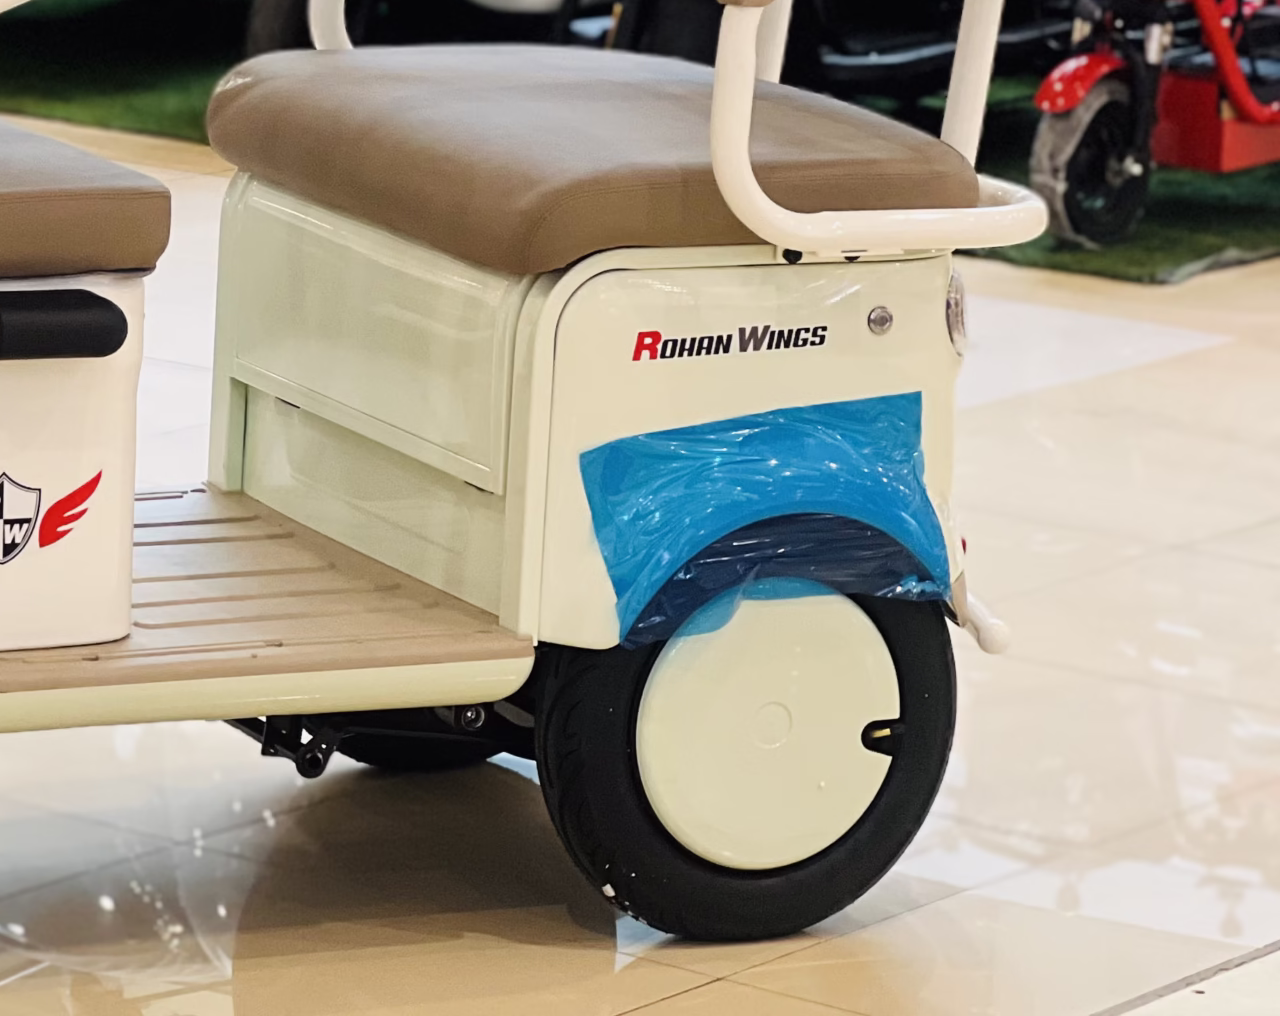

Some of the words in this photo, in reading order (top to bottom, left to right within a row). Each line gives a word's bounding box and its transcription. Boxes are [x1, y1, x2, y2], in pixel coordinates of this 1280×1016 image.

[632, 330, 733, 361] ROHAN
[738, 325, 827, 352] WINGS
[4, 523, 29, 544] W
